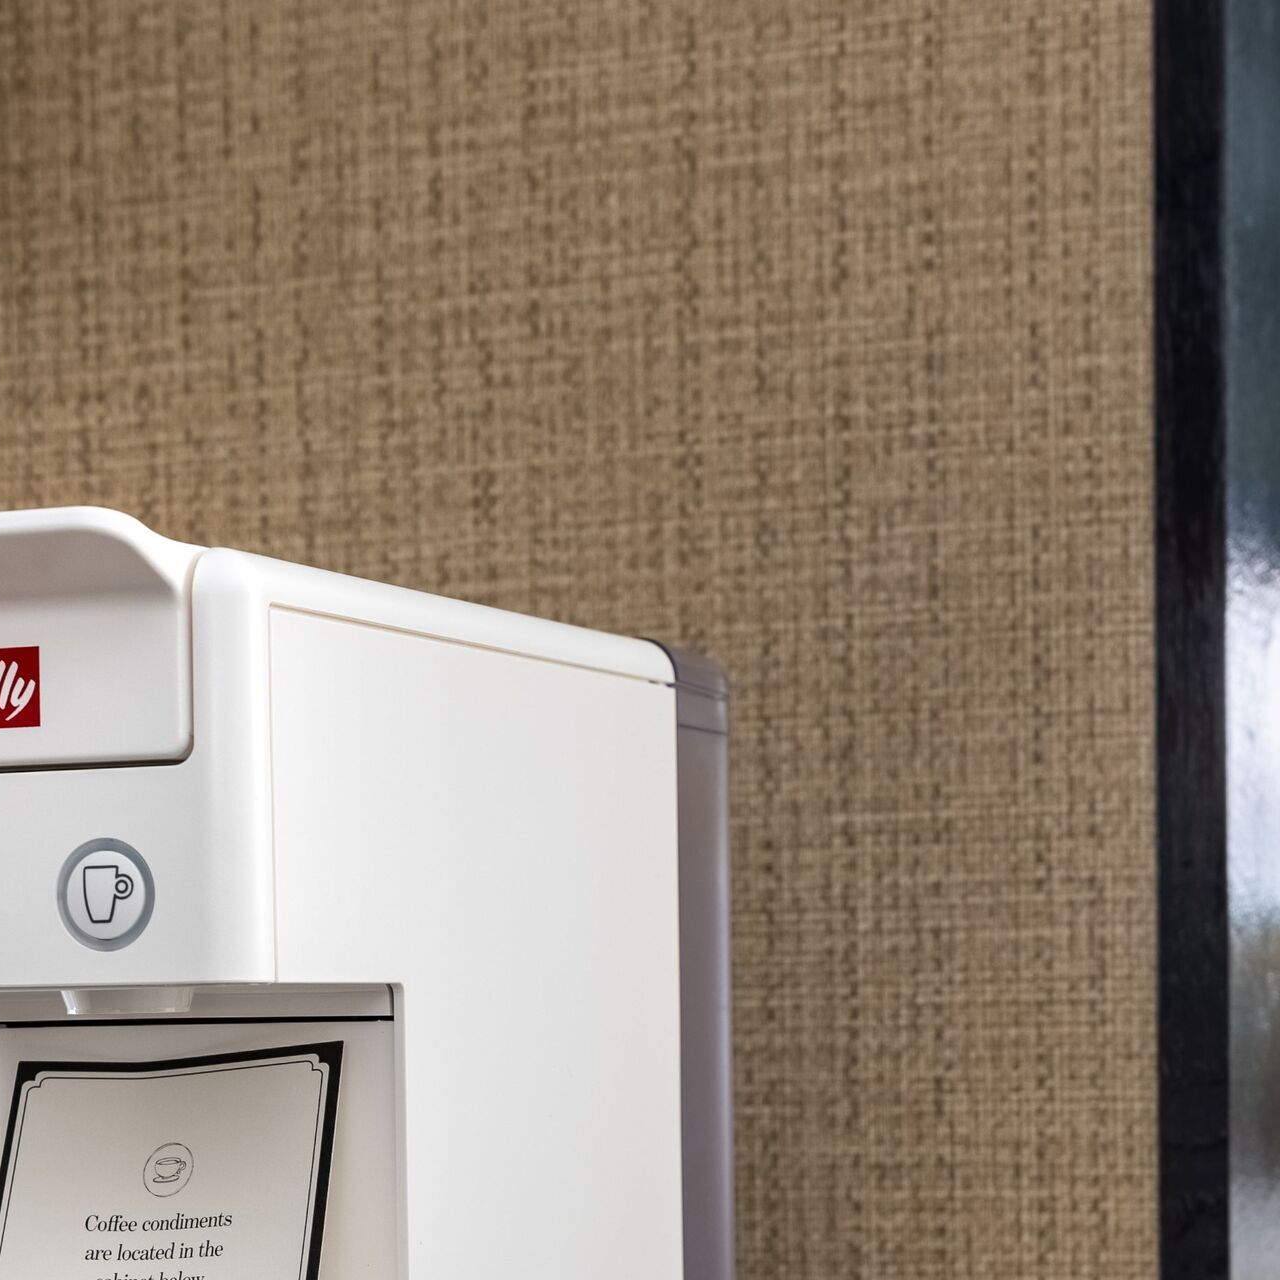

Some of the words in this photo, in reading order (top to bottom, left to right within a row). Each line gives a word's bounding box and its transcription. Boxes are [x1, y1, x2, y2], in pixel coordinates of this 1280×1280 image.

[85, 1214, 138, 1232] Coffee
[142, 1212, 233, 1232] condiments
[84, 1248, 112, 1261] are
[117, 1242, 175, 1261] located
[179, 1242, 194, 1259] in
[198, 1239, 224, 1258] the
